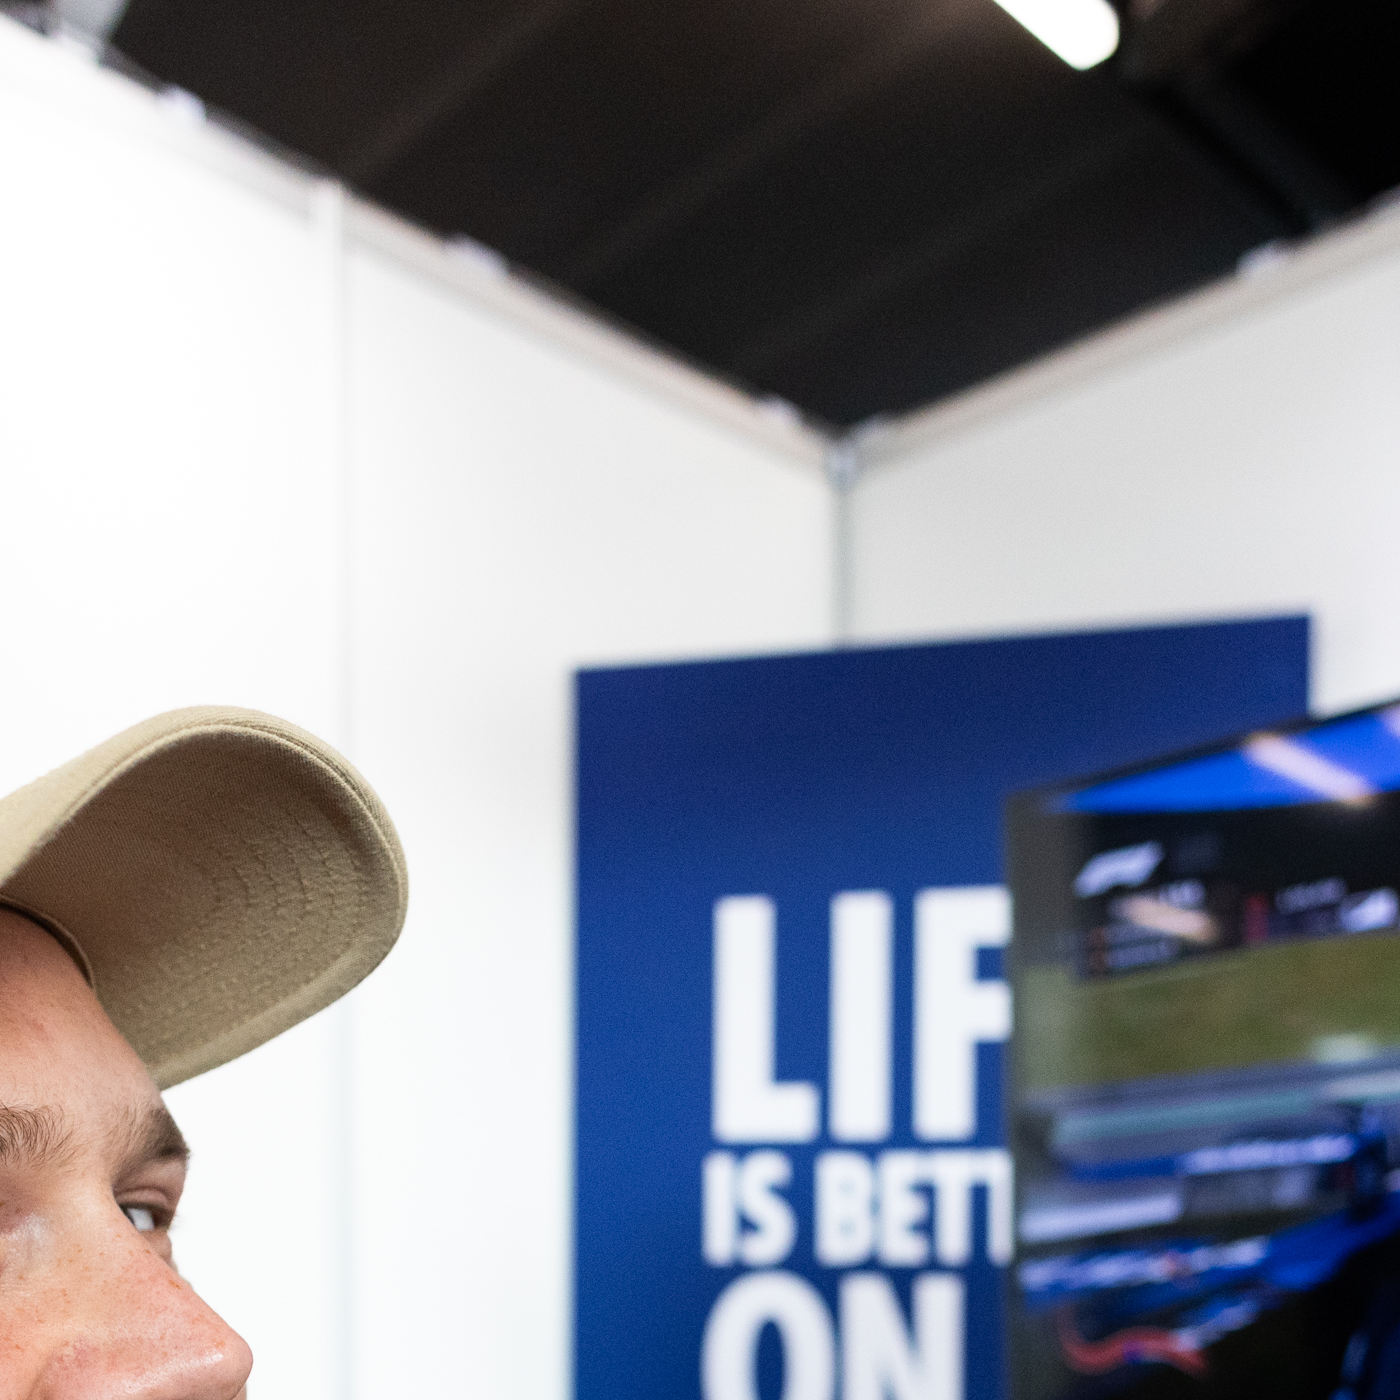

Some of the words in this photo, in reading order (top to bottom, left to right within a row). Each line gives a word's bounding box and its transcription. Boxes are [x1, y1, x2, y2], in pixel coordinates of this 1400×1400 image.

[711, 885, 1013, 1144] LIF
[702, 1150, 796, 1267] IS
[814, 1148, 1014, 1267] BETT
